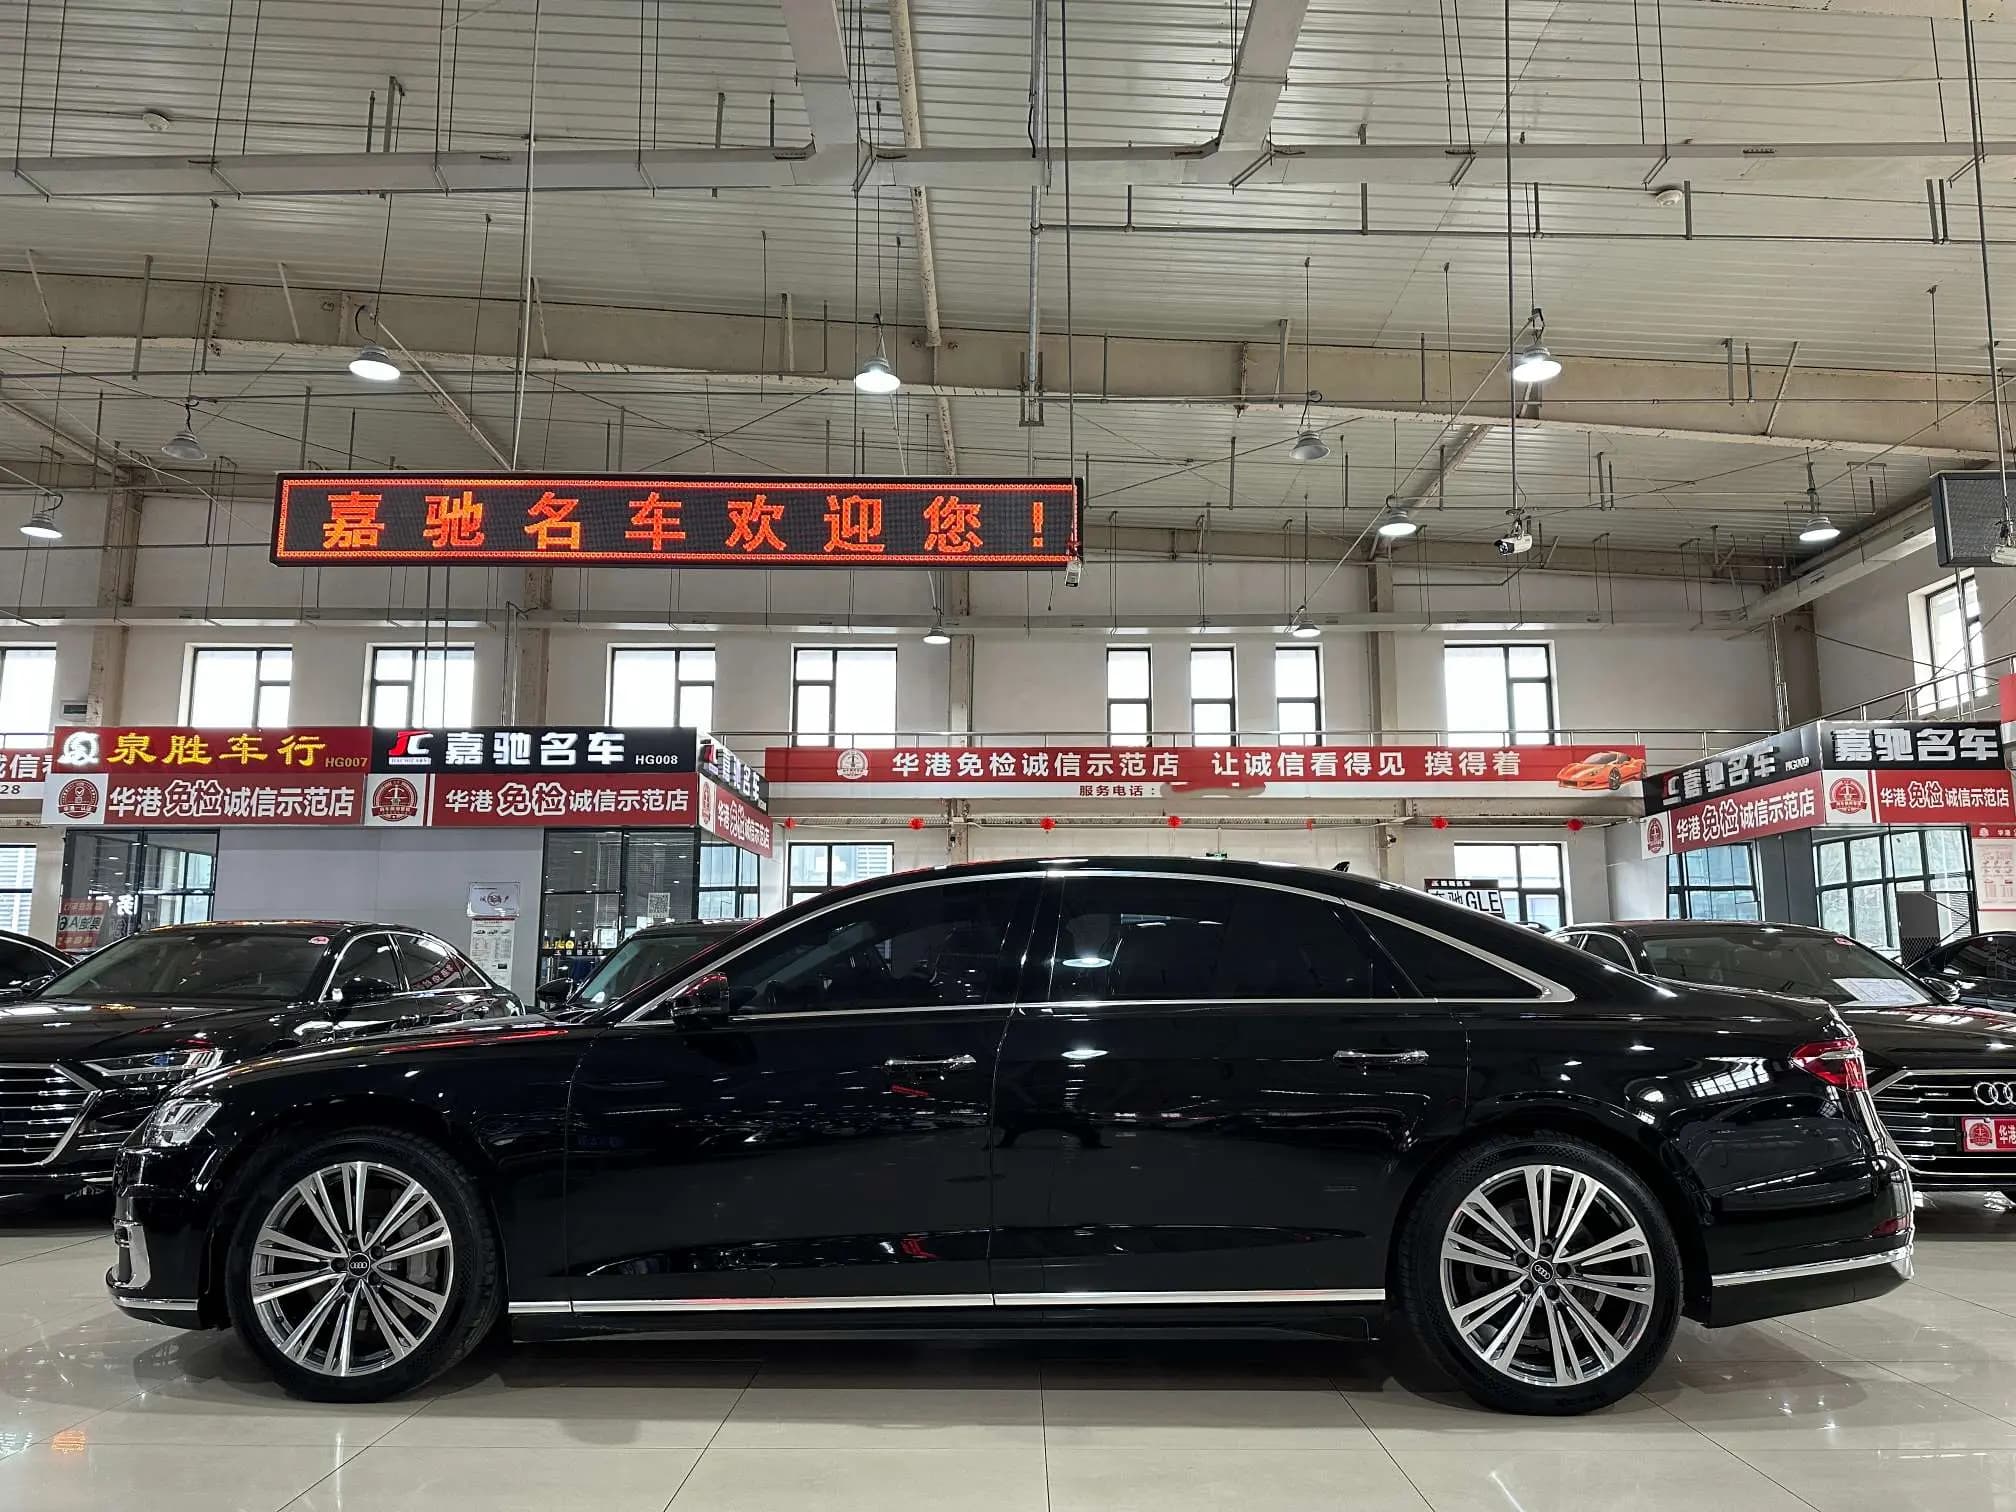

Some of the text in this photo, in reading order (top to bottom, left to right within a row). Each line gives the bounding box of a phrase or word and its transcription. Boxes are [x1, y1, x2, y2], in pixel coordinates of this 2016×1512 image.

[107, 732, 326, 766] 泉胜车行
[325, 757, 368, 768] HG007
[445, 732, 625, 766] 嘉驰名车
[635, 755, 678, 765] HG008
[1833, 728, 2000, 763] 嘉驰名车
[892, 751, 1179, 777] 华港免检诚信示范店
[1211, 751, 1522, 777] 让诚信看得见 摸得着
[108, 780, 355, 817] 华港免检诚信示范店
[445, 782, 689, 816] 华港免检诚信示范店
[1880, 780, 2009, 808] 华港免检诚信示范店
[1676, 788, 1816, 843] 华港免检诚信示范店
